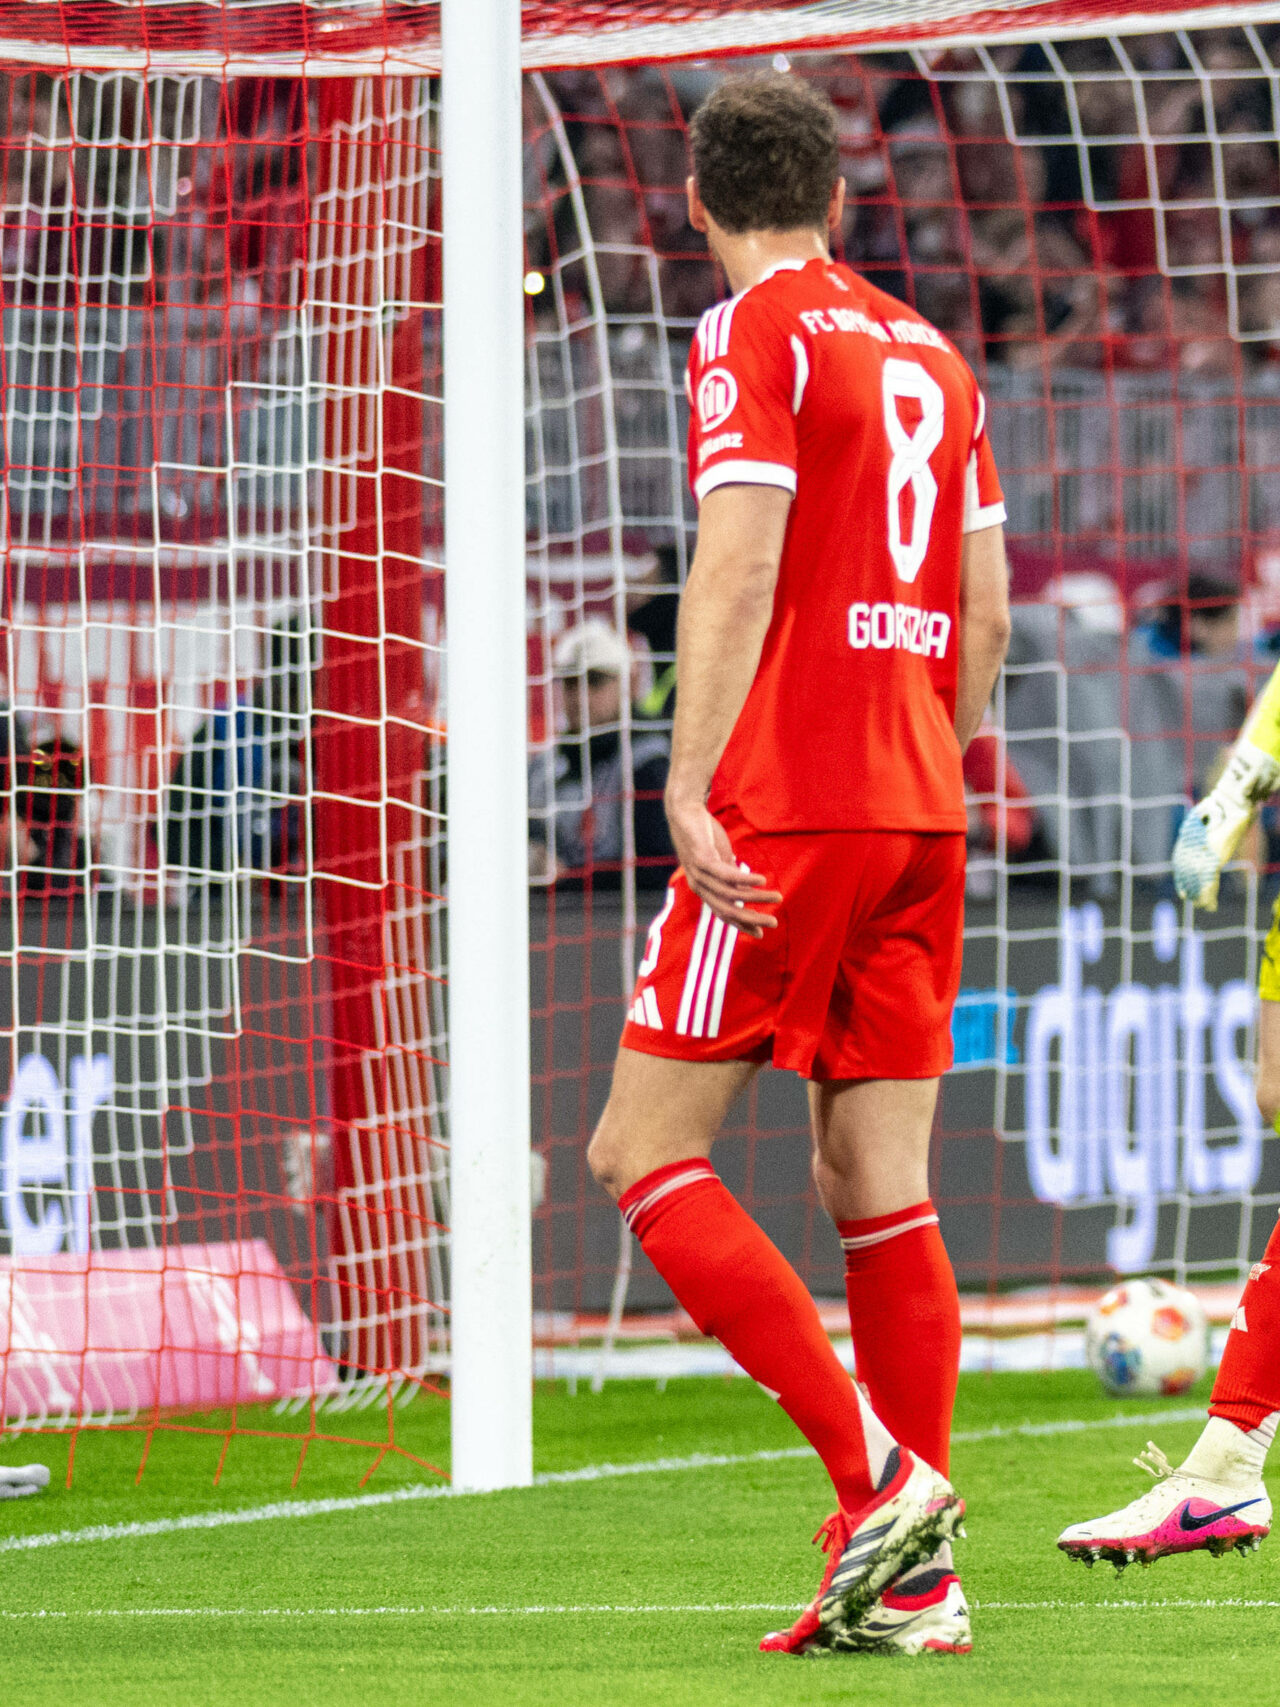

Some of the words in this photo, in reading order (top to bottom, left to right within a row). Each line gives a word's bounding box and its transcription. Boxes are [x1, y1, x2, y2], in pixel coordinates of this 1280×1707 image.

[799, 309, 835, 335] FC
[882, 357, 944, 583] 8
[1024, 898, 1263, 1274] digits
